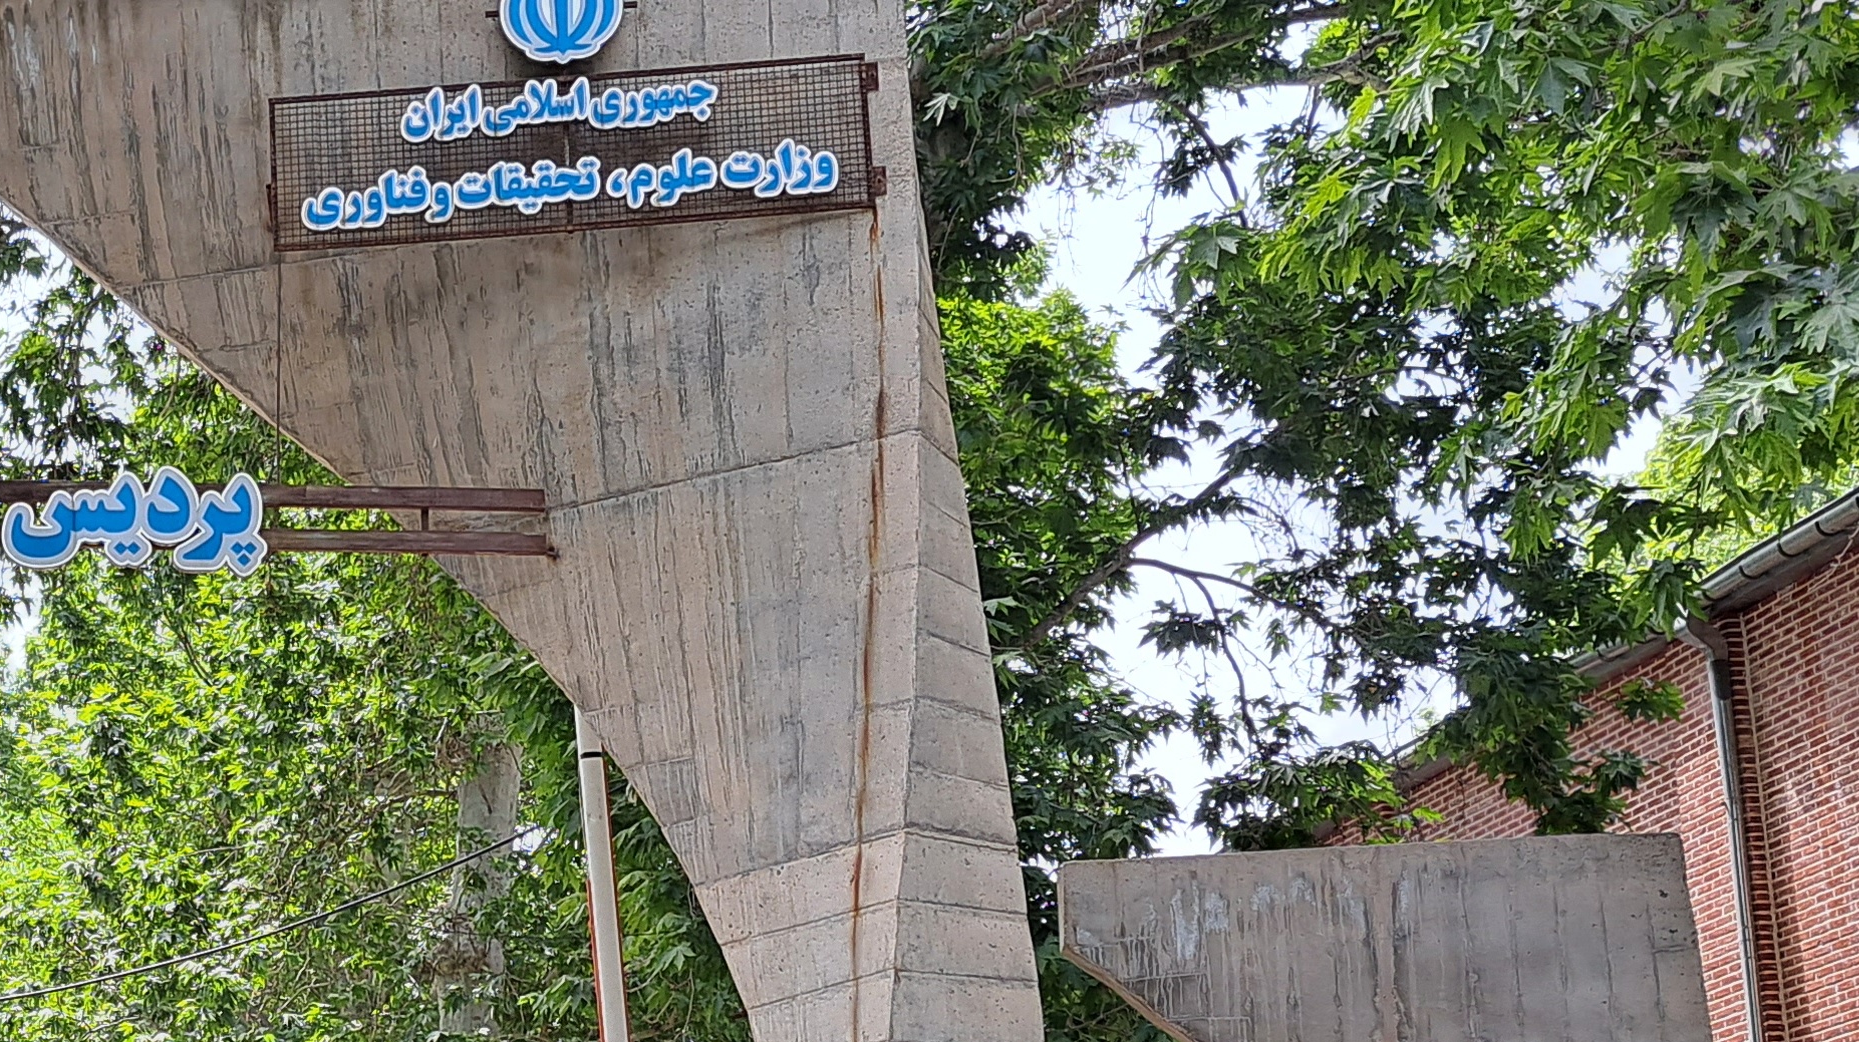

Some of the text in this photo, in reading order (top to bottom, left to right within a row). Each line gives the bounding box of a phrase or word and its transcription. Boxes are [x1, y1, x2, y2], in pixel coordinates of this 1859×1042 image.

[401, 77, 718, 143] جمهوری اسلامی ایران
[301, 164, 432, 231] فناوری
[452, 155, 601, 215] تحقیقات
[720, 138, 839, 198] وزارت
[3, 466, 268, 577] پردیس
